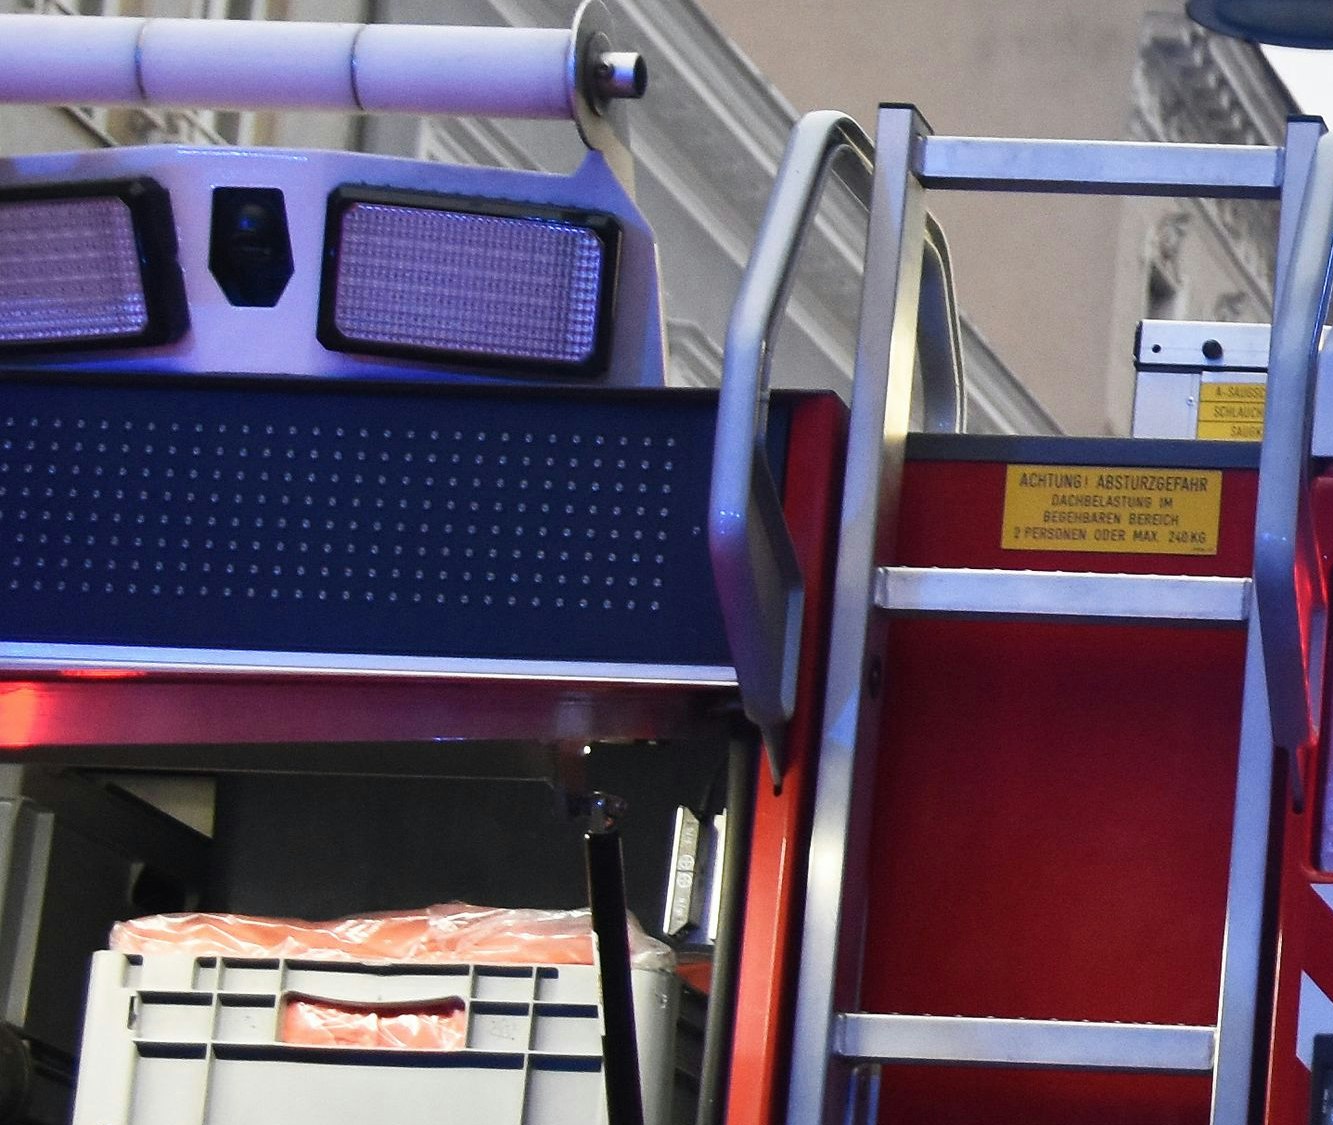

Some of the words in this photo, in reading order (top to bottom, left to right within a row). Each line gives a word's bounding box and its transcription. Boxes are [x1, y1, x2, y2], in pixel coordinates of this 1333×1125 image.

[1097, 474, 1208, 492] ABSTURZGEFAHR
[1052, 494, 1152, 509] DACHBELASTUNG
[1159, 497, 1173, 509] IM
[1044, 511, 1121, 525] BEGEHBAREN
[1129, 513, 1179, 526] BEREICH
[1024, 527, 1087, 541] PERSONEN
[1094, 529, 1126, 542] ODER
